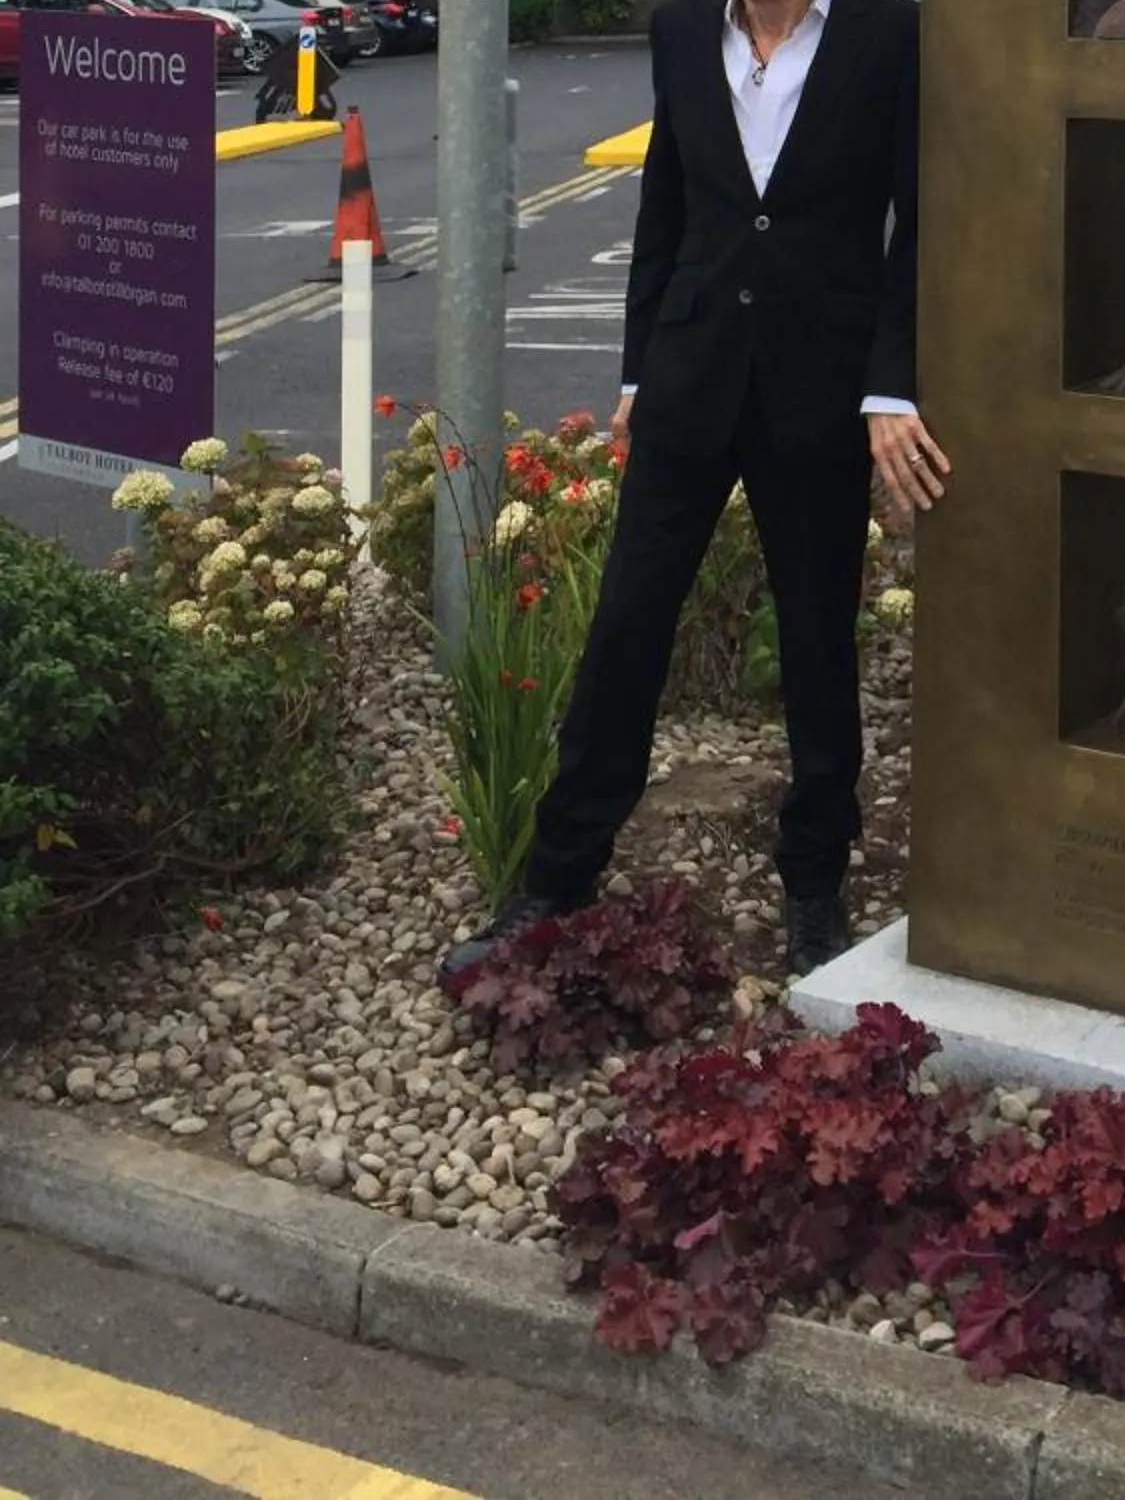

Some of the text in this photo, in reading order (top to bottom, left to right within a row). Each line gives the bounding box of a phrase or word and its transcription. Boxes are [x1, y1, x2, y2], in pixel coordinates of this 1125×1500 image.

[44, 35, 186, 85] Welcome
[37, 119, 58, 136] Our
[61, 125, 79, 138] car
[81, 125, 106, 142] park
[123, 127, 139, 145] for
[142, 130, 163, 148] the
[167, 136, 189, 151] use
[59, 141, 88, 160] hotel
[91, 148, 151, 167] customers
[153, 152, 179, 174] only
[39, 203, 197, 240] For parking permits contact
[77, 233, 155, 260] 01 200 1800
[109, 261, 122, 274] or
[53, 331, 179, 368] Clamping in operation
[57, 355, 174, 394] Release fee of €120
[47, 443, 91, 466] TALBOT
